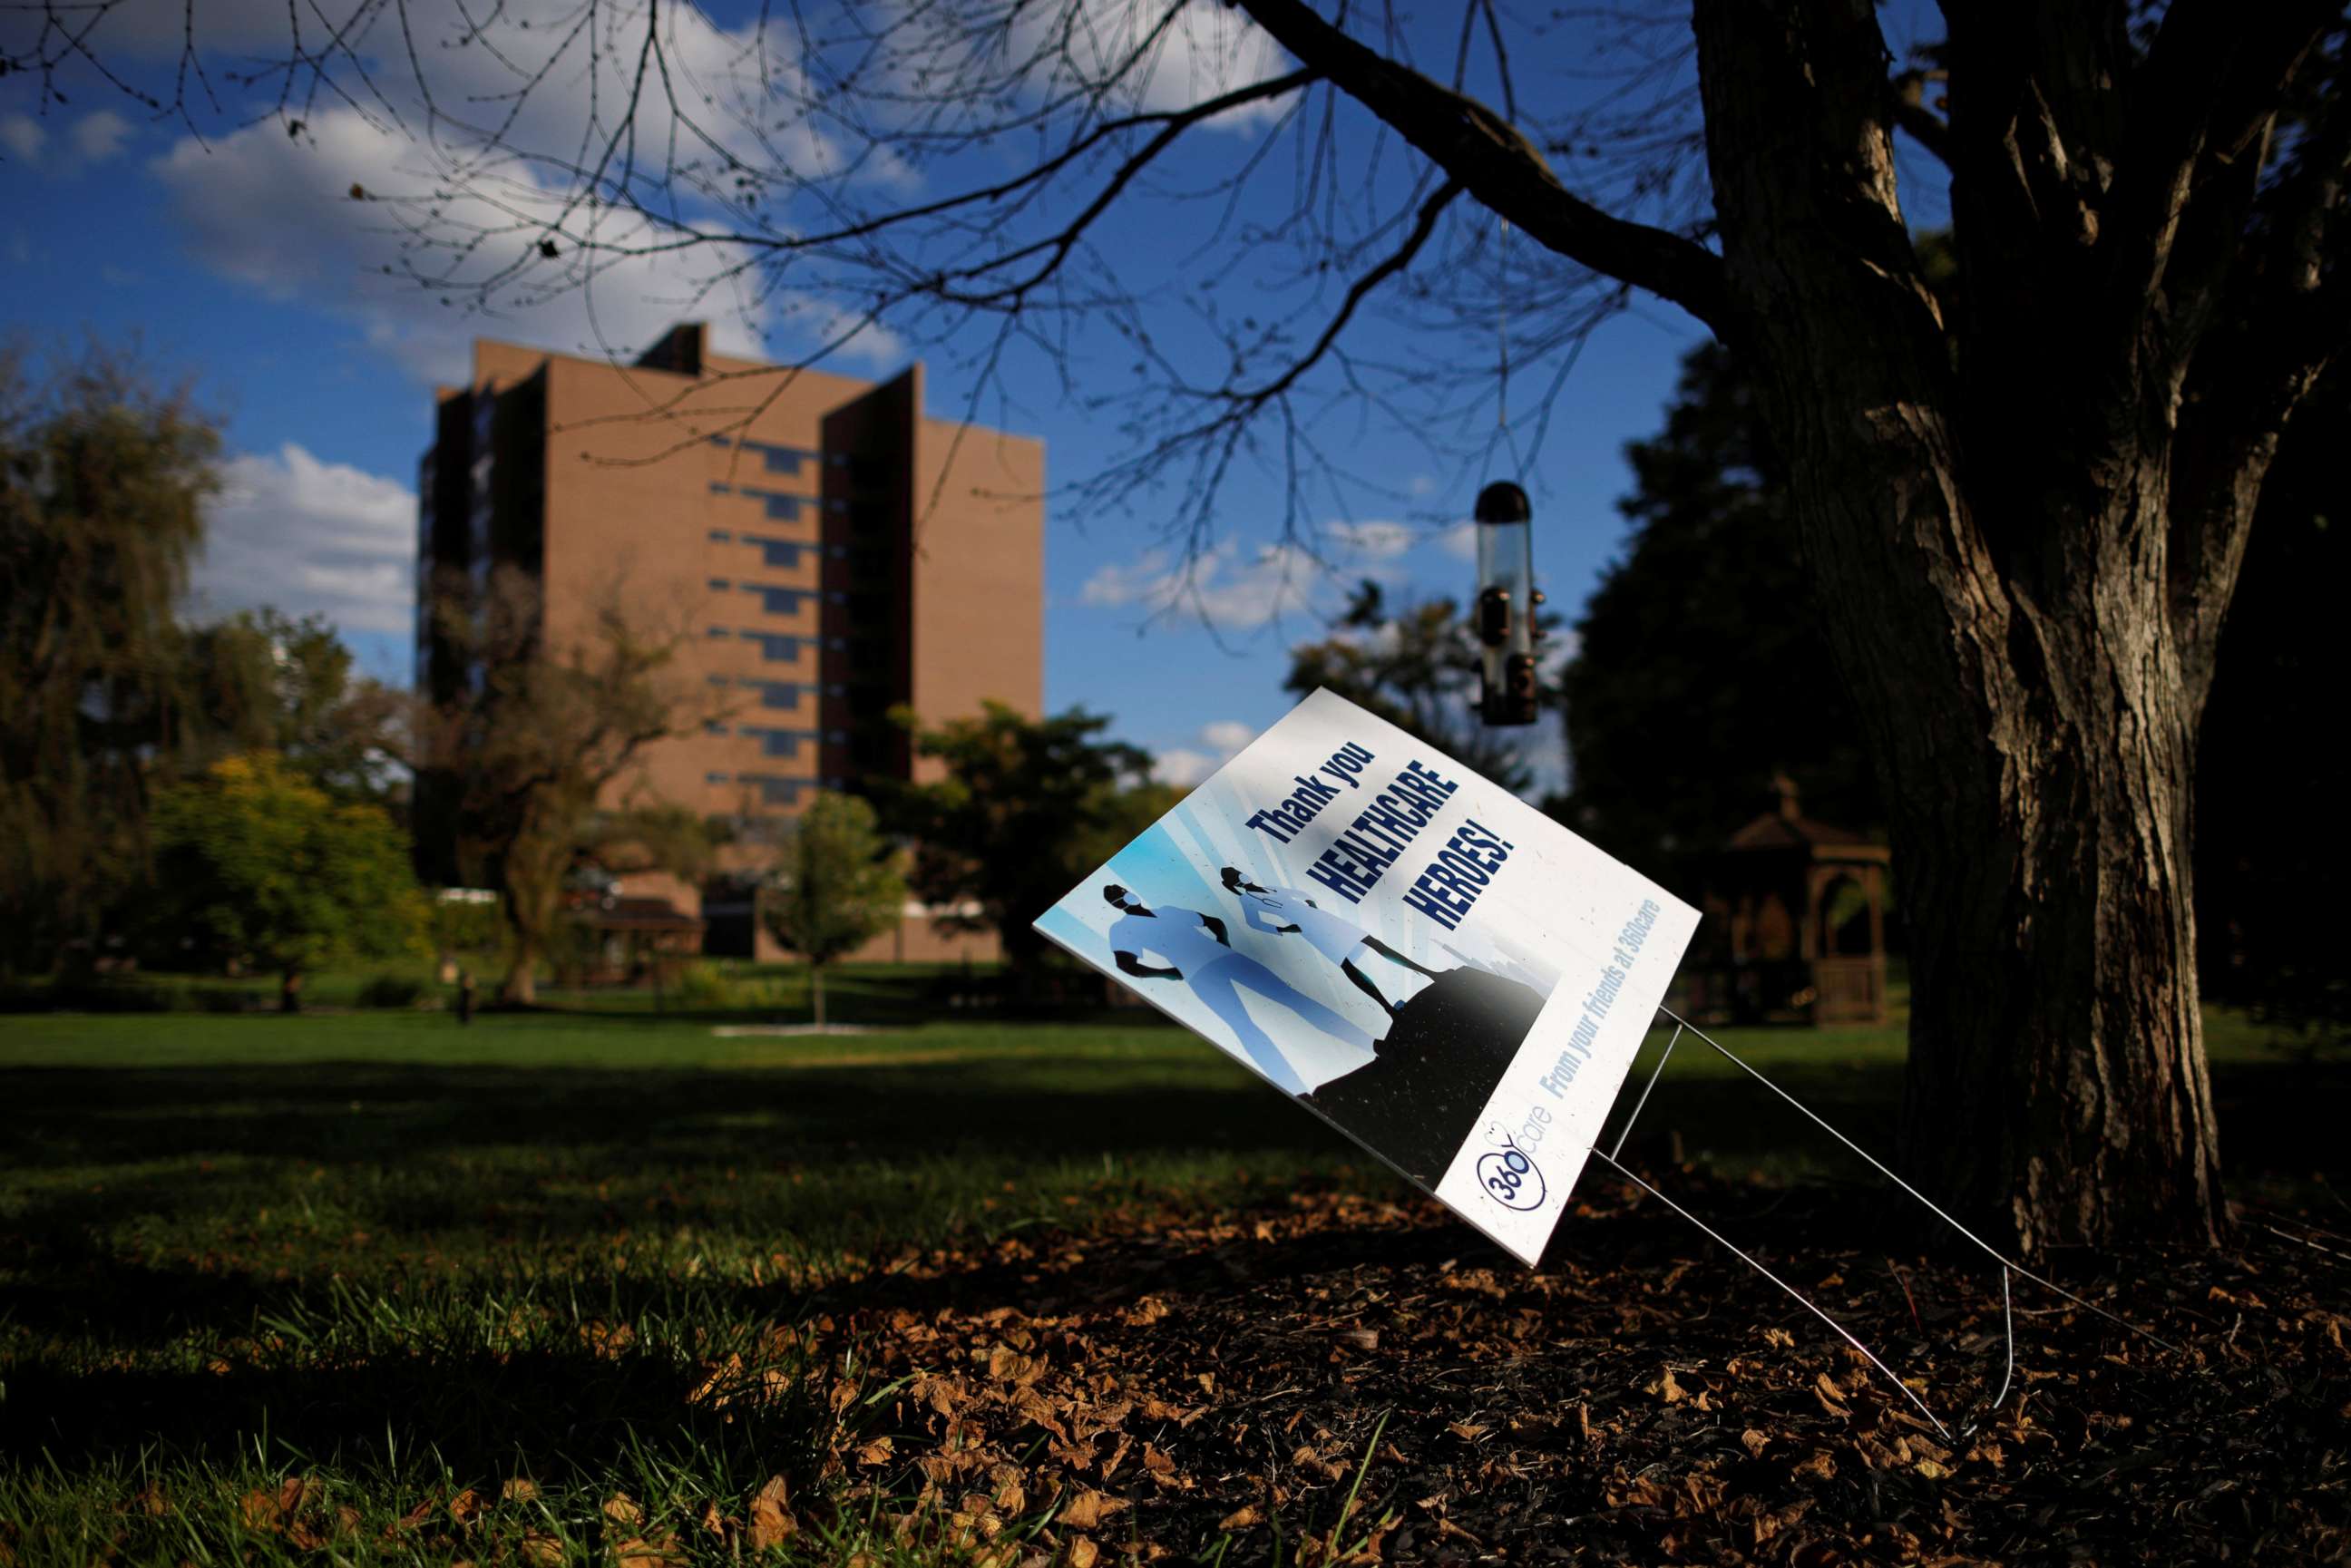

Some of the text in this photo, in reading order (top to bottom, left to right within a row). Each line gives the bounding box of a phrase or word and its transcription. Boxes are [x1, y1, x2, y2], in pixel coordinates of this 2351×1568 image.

[1245, 741, 1376, 843] Thank you
[1305, 759, 1458, 904] HEALTHCARE
[1401, 818, 1515, 931] HEROES!
[1538, 898, 1661, 1099] From your friends at 360care
